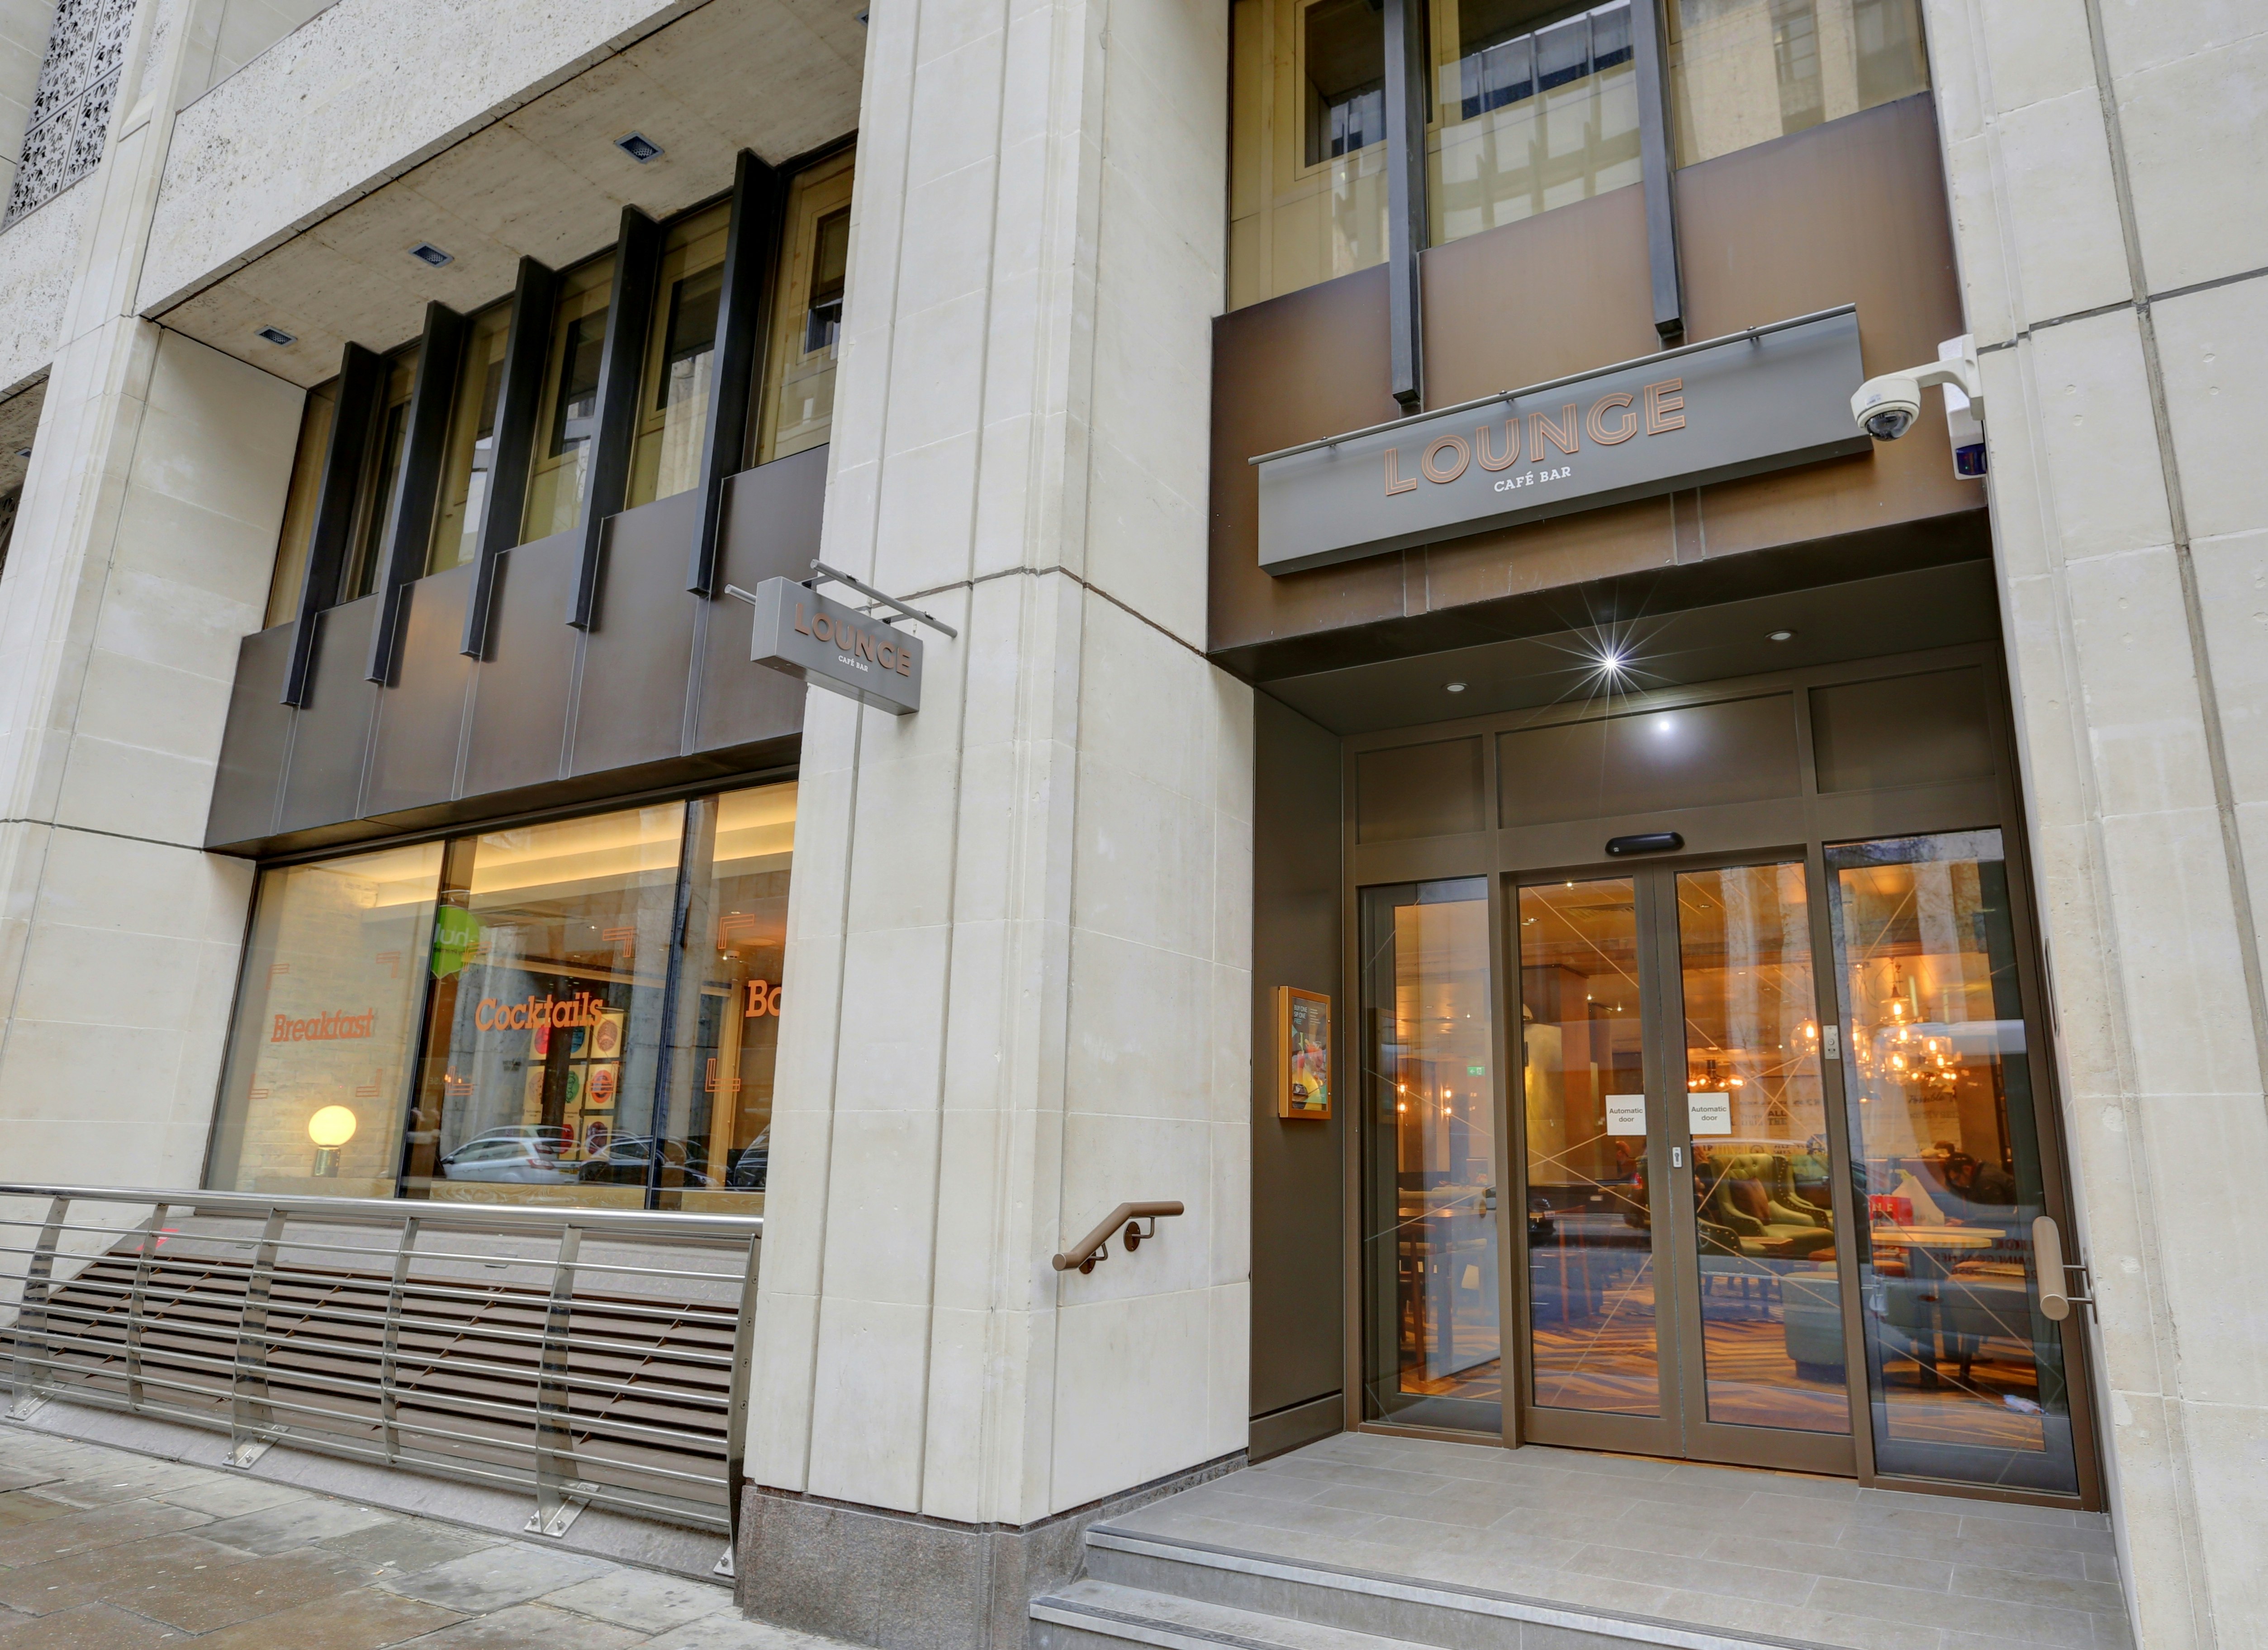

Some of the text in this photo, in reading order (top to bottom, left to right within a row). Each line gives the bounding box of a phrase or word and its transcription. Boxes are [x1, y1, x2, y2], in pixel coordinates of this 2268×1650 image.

[1385, 378, 1685, 496] LOUNGE
[1494, 466, 1571, 493] CAFÉ BAR
[795, 603, 912, 677] LOUNGE
[838, 655, 868, 673] CAFÉ BAR
[271, 1008, 374, 1042] Breakfast
[475, 992, 603, 1032] Cocktails
